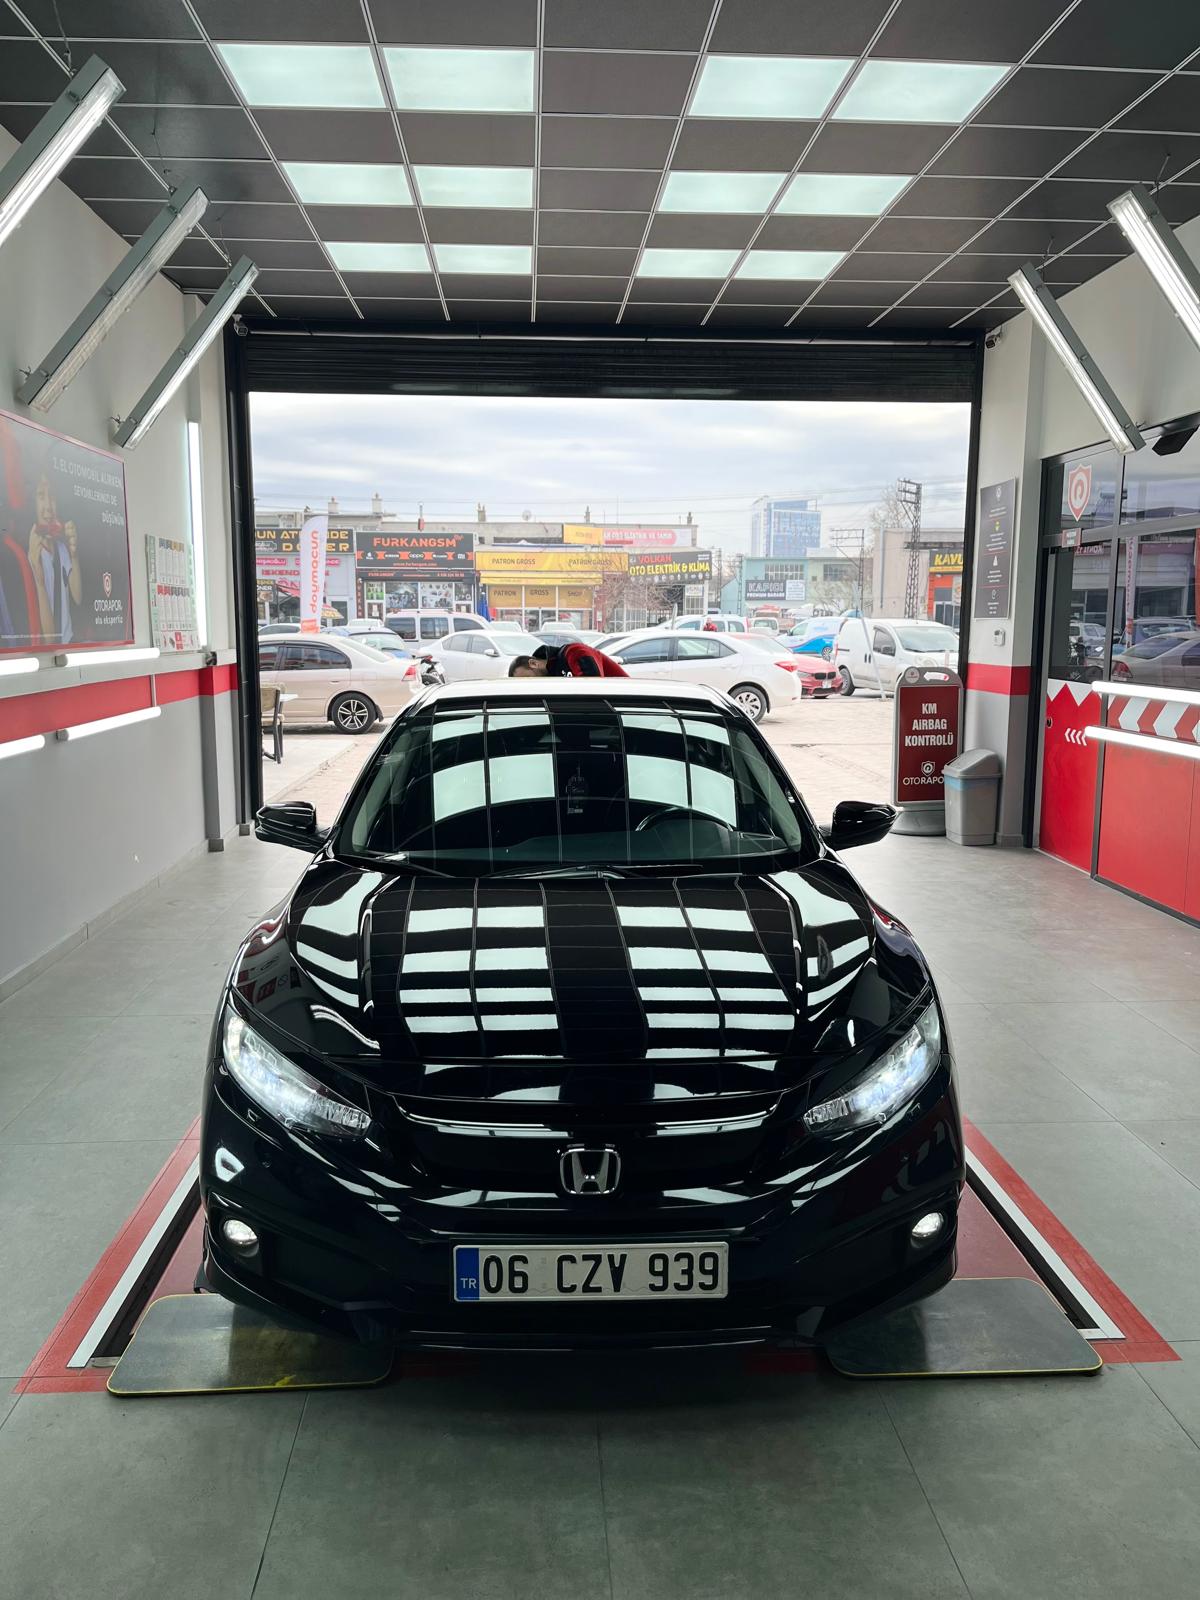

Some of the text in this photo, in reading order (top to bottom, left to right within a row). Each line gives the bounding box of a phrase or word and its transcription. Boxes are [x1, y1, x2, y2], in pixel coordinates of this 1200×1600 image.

[492, 558, 536, 566] PATRON GROSS
[629, 560, 710, 576] OTO ELEKTRİK & KLİMA
[922, 703, 937, 714] KM
[904, 732, 954, 747] KONTROLÜ
[902, 776, 945, 786] OTORAPO
[483, 1251, 719, 1294] 06 CZV 939
[460, 1278, 477, 1289] TR
